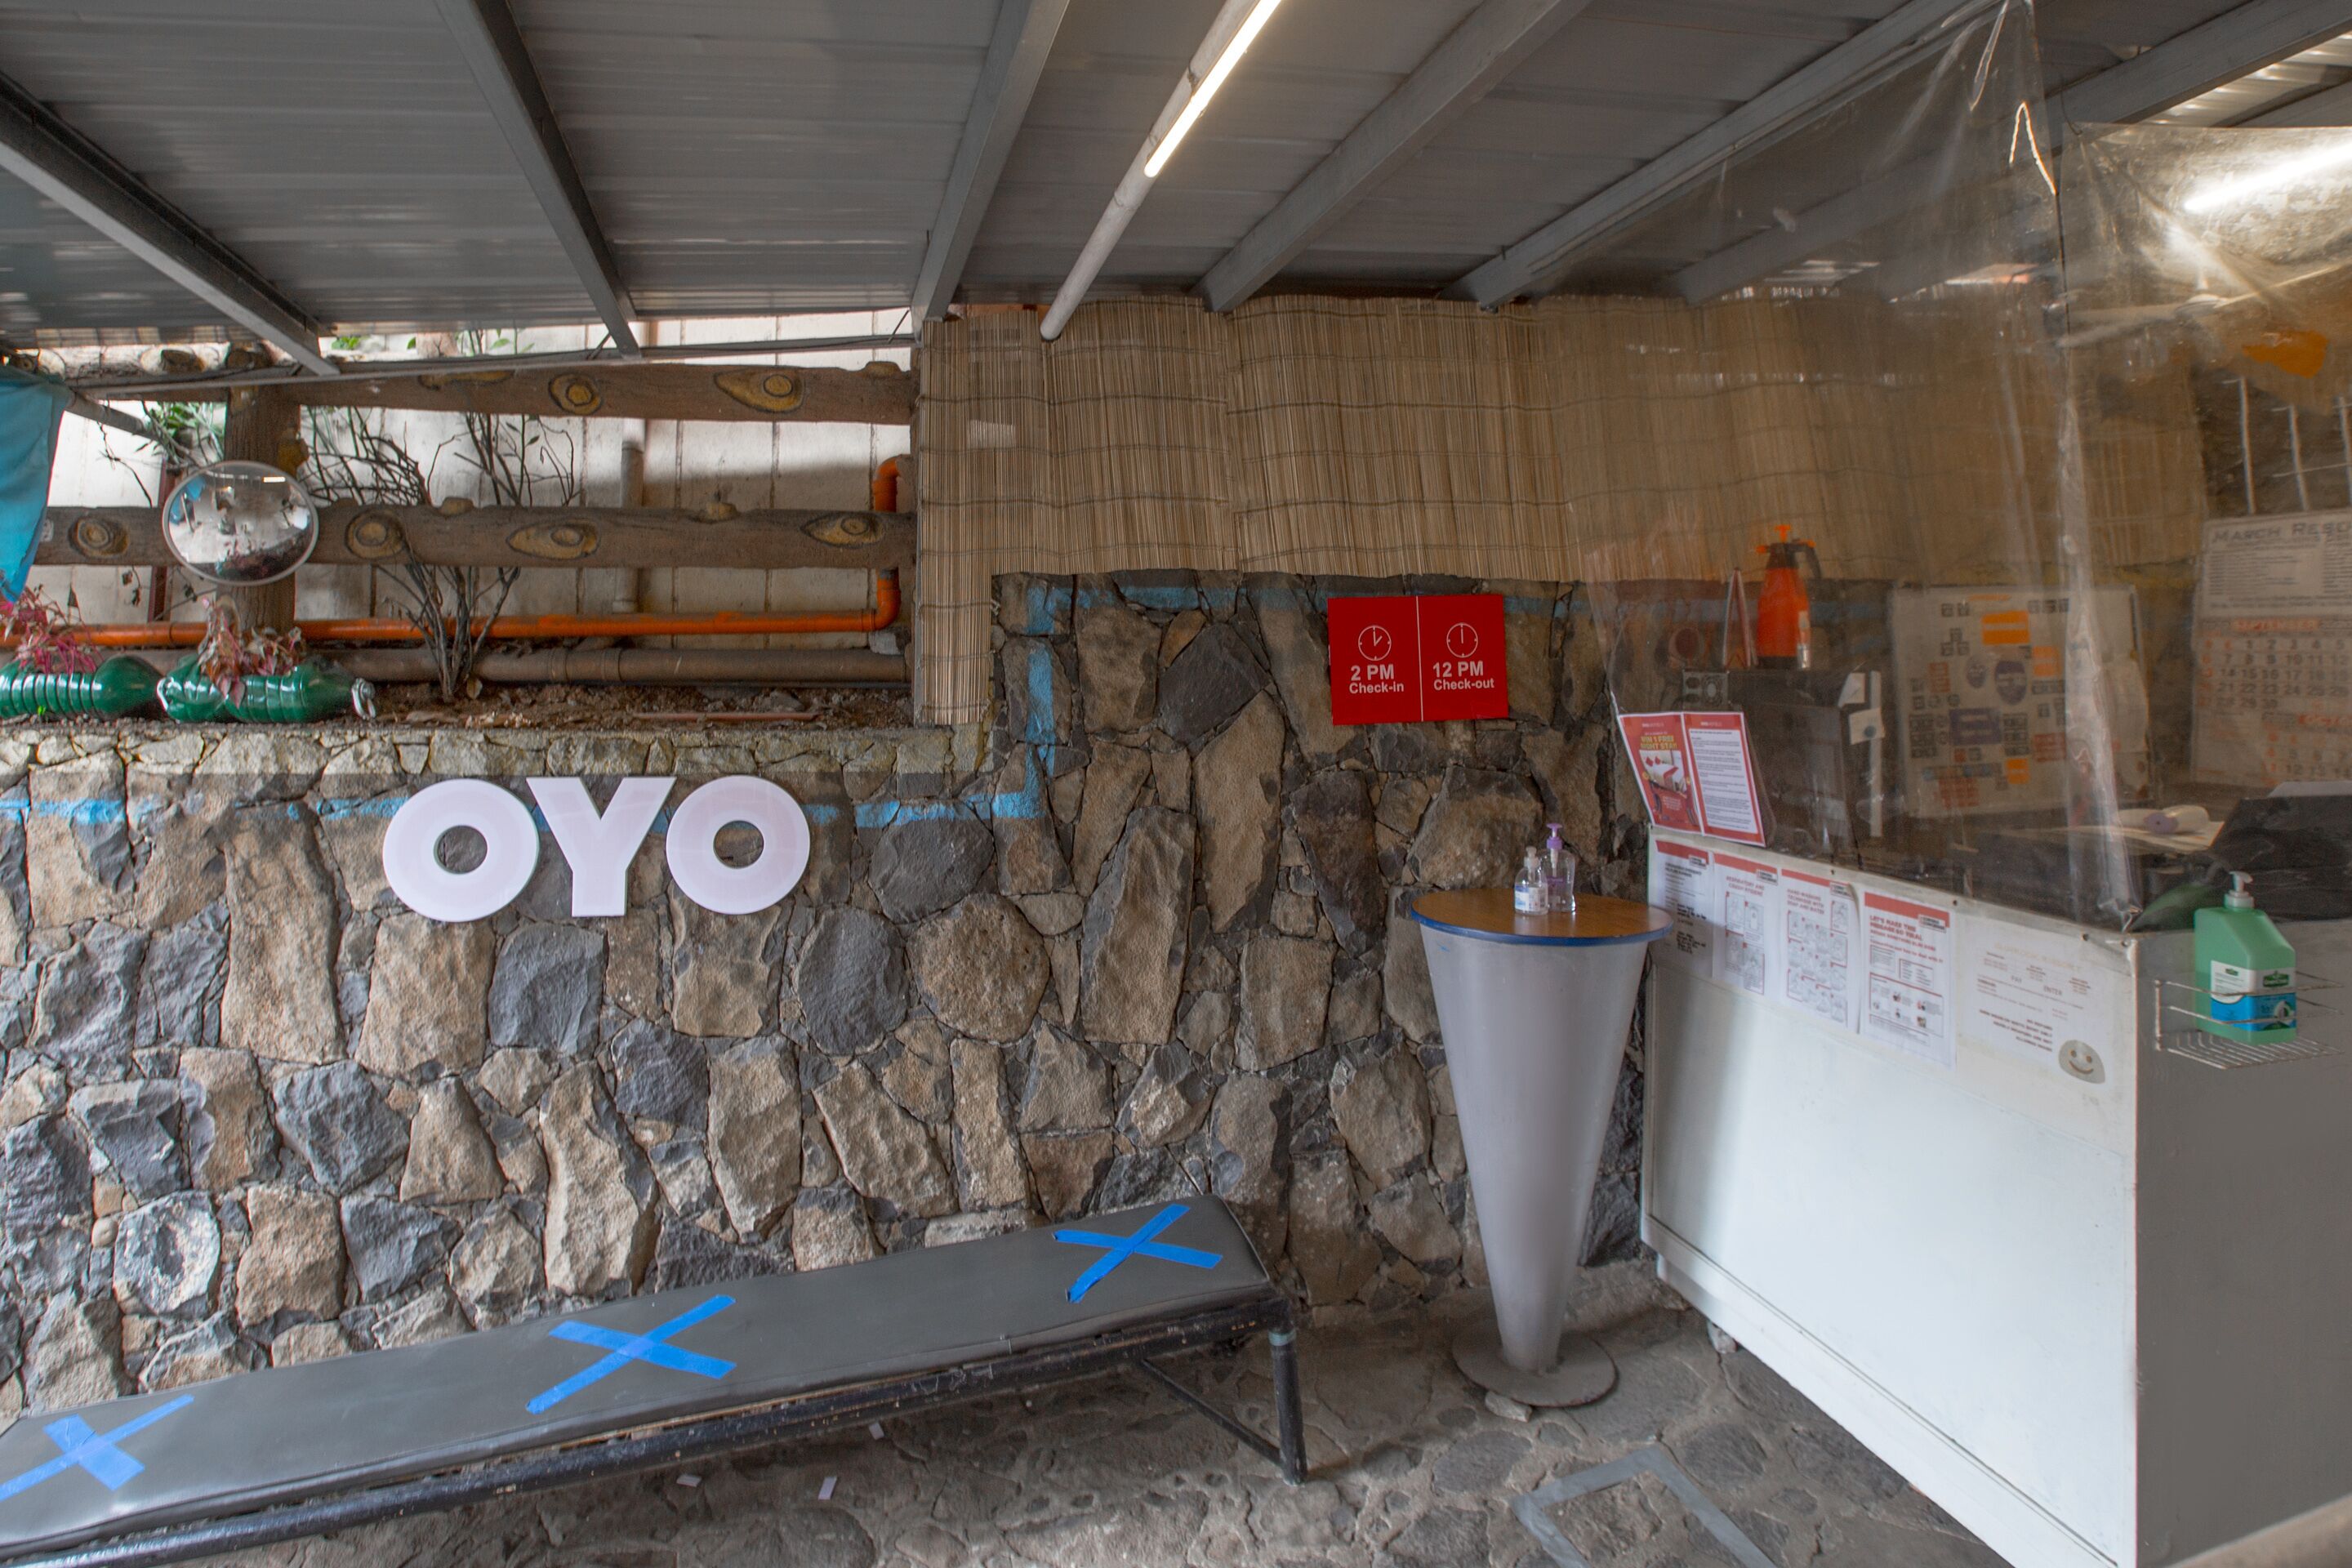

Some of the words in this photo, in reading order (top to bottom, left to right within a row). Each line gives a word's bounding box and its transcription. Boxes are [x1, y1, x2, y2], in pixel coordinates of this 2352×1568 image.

[1351, 666, 1361, 681] 2
[1366, 664, 1395, 681] PM
[1432, 662, 1452, 678] 12
[1458, 660, 1484, 677] PM
[1349, 681, 1405, 694] Check-in
[1433, 677, 1495, 691] Check-out
[382, 775, 810, 922] OYO
